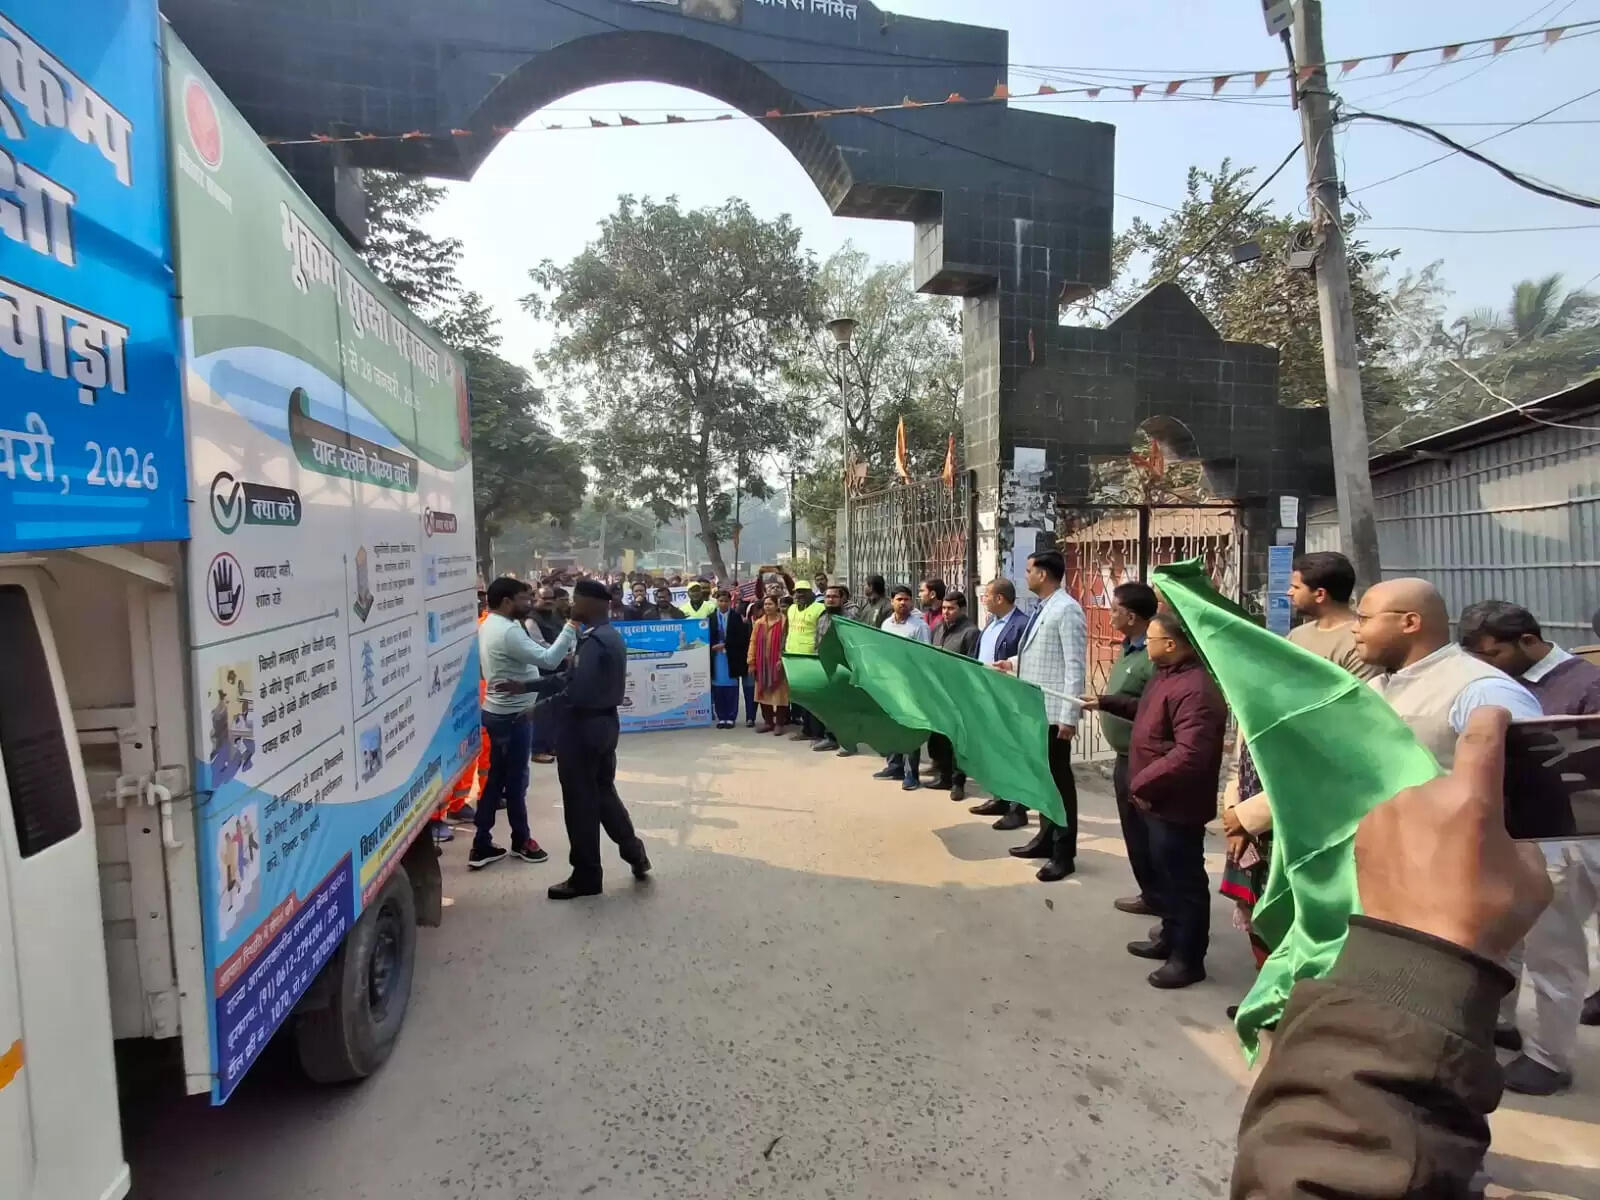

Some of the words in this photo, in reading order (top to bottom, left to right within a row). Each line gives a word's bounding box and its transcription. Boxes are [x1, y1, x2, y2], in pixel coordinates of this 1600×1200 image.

[85, 441, 159, 491] 2026
[311, 438, 337, 467] याद
[339, 447, 368, 477] रखने
[370, 452, 393, 482] योग्य
[251, 499, 276, 521] क्या
[276, 496, 297, 521] करें
[259, 654, 277, 672] किसी
